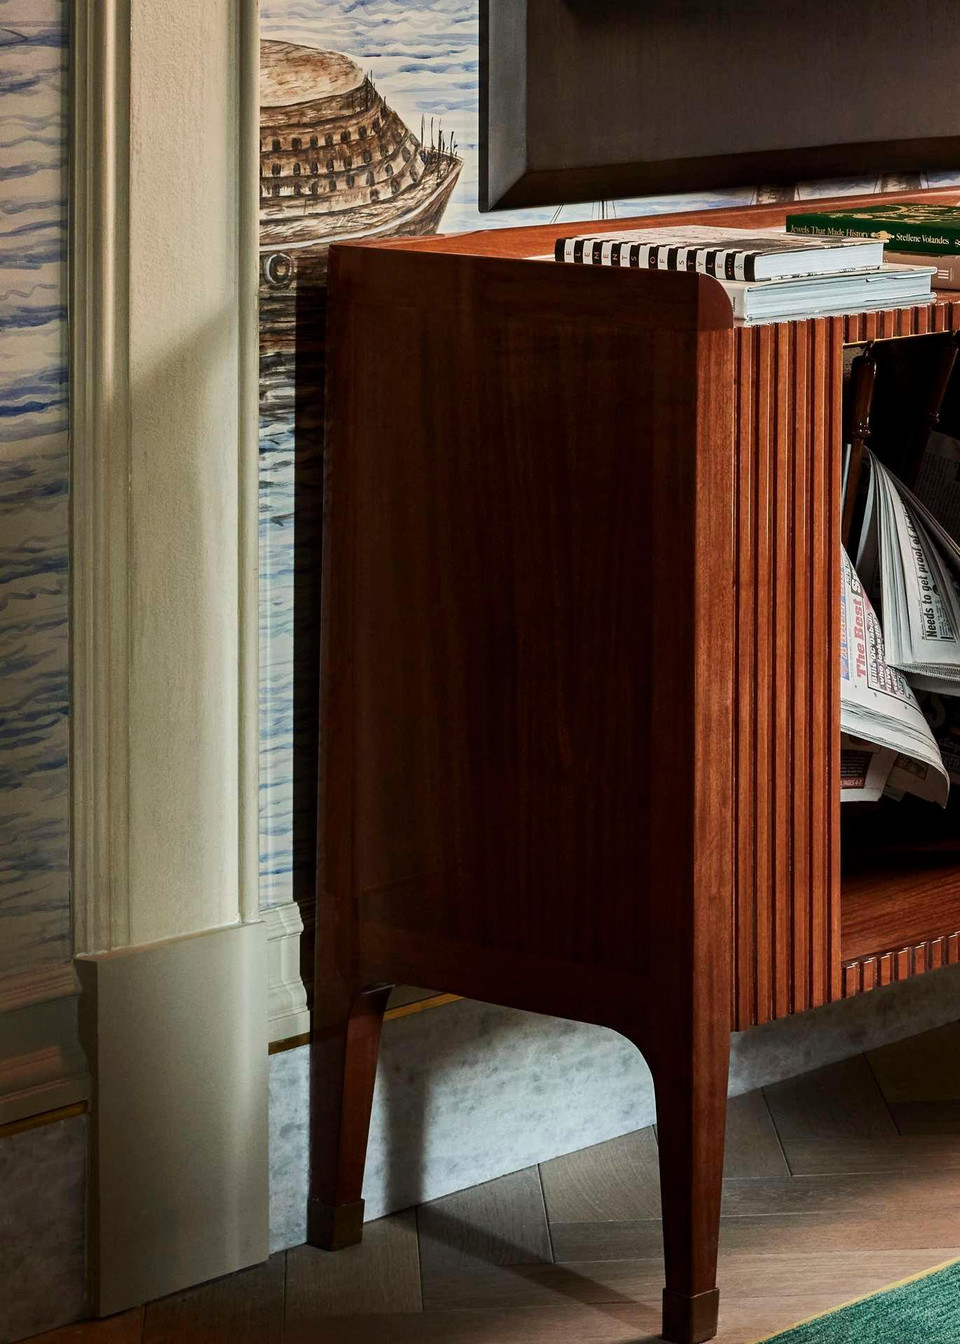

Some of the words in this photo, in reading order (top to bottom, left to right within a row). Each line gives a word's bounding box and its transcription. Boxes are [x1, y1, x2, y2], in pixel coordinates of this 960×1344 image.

[790, 224, 810, 234] Jewels
[810, 226, 826, 235] That
[826, 228, 845, 237] Made
[846, 229, 870, 239] History
[896, 233, 922, 244] Stellene
[922, 235, 950, 246] Volandes
[909, 534, 920, 546] of
[912, 547, 928, 574] proof
[918, 575, 932, 592] get
[922, 594, 932, 605] to
[852, 598, 864, 641] Best
[923, 607, 938, 638] Needs
[855, 643, 867, 678] The
